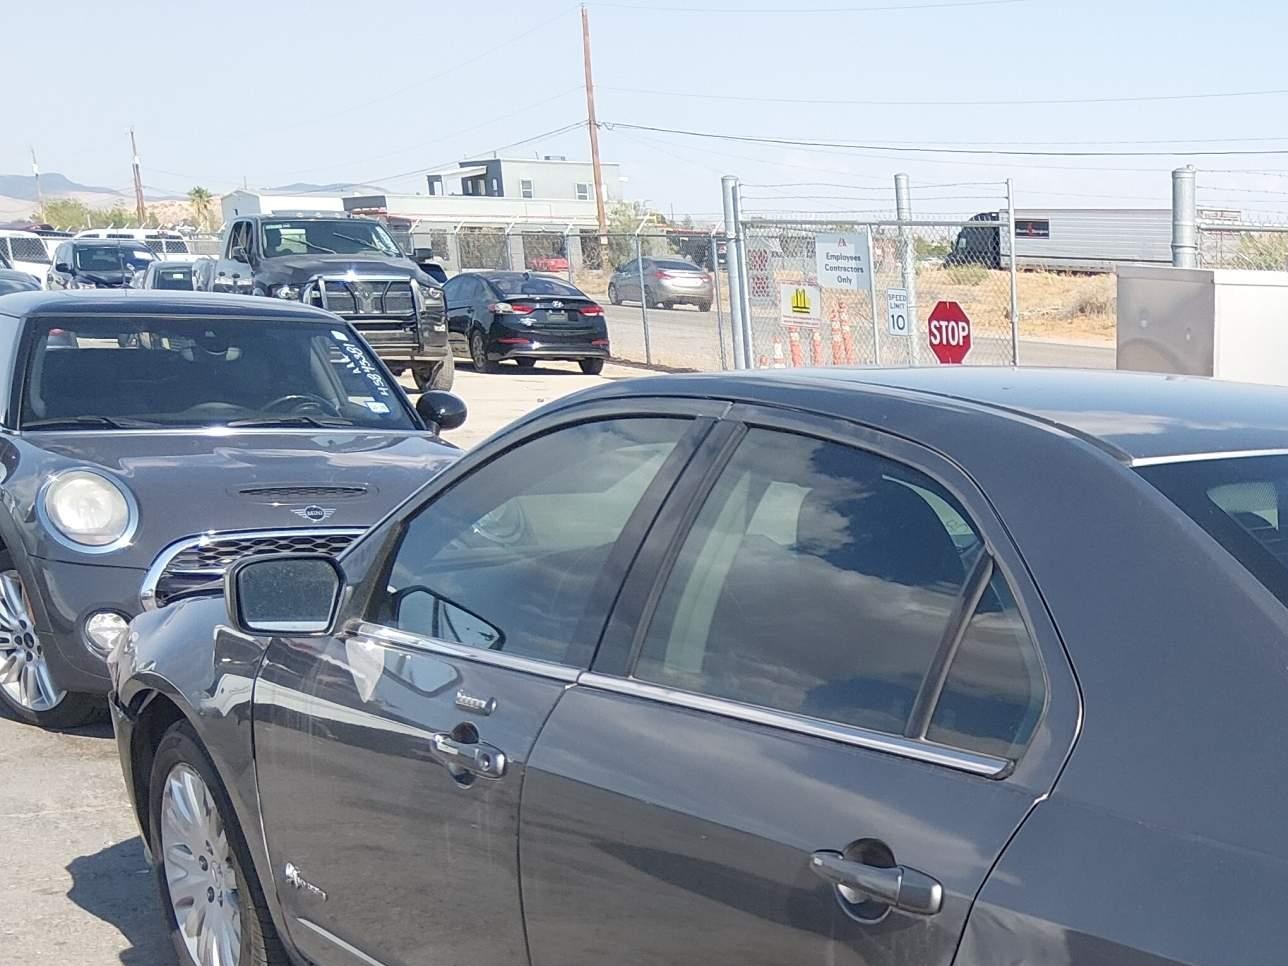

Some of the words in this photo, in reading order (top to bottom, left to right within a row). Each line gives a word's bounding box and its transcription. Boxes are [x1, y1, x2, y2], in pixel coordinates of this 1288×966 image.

[826, 252, 862, 262] Employees
[824, 264, 864, 273] Contractors
[836, 275, 853, 285] Only
[888, 294, 907, 302] SPEED
[890, 302, 905, 310] LIMIT
[891, 314, 906, 331] 10
[930, 320, 969, 346] STOP
